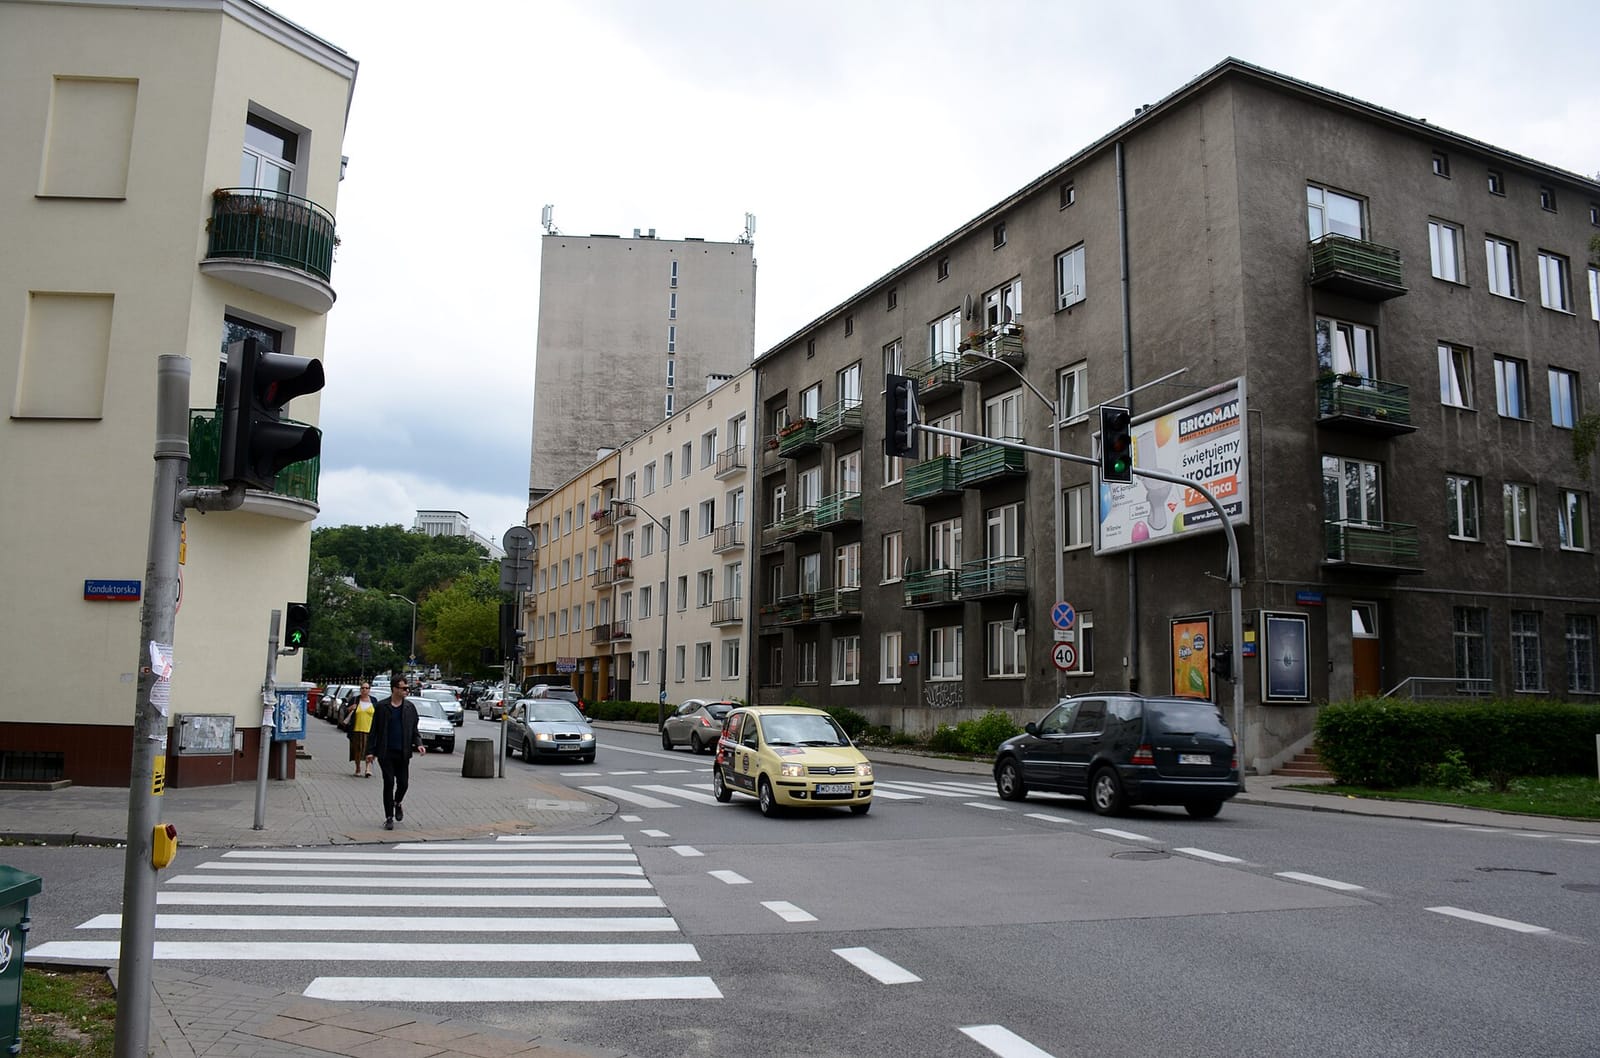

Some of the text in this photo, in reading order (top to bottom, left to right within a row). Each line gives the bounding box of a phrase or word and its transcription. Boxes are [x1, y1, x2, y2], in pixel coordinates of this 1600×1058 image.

[1180, 402, 1239, 435] BRICOMAN
[1183, 439, 1240, 467] świętujemy
[1207, 481, 1233, 498] lipca
[87, 584, 137, 594] Konduktorska
[1056, 649, 1073, 663] 40
